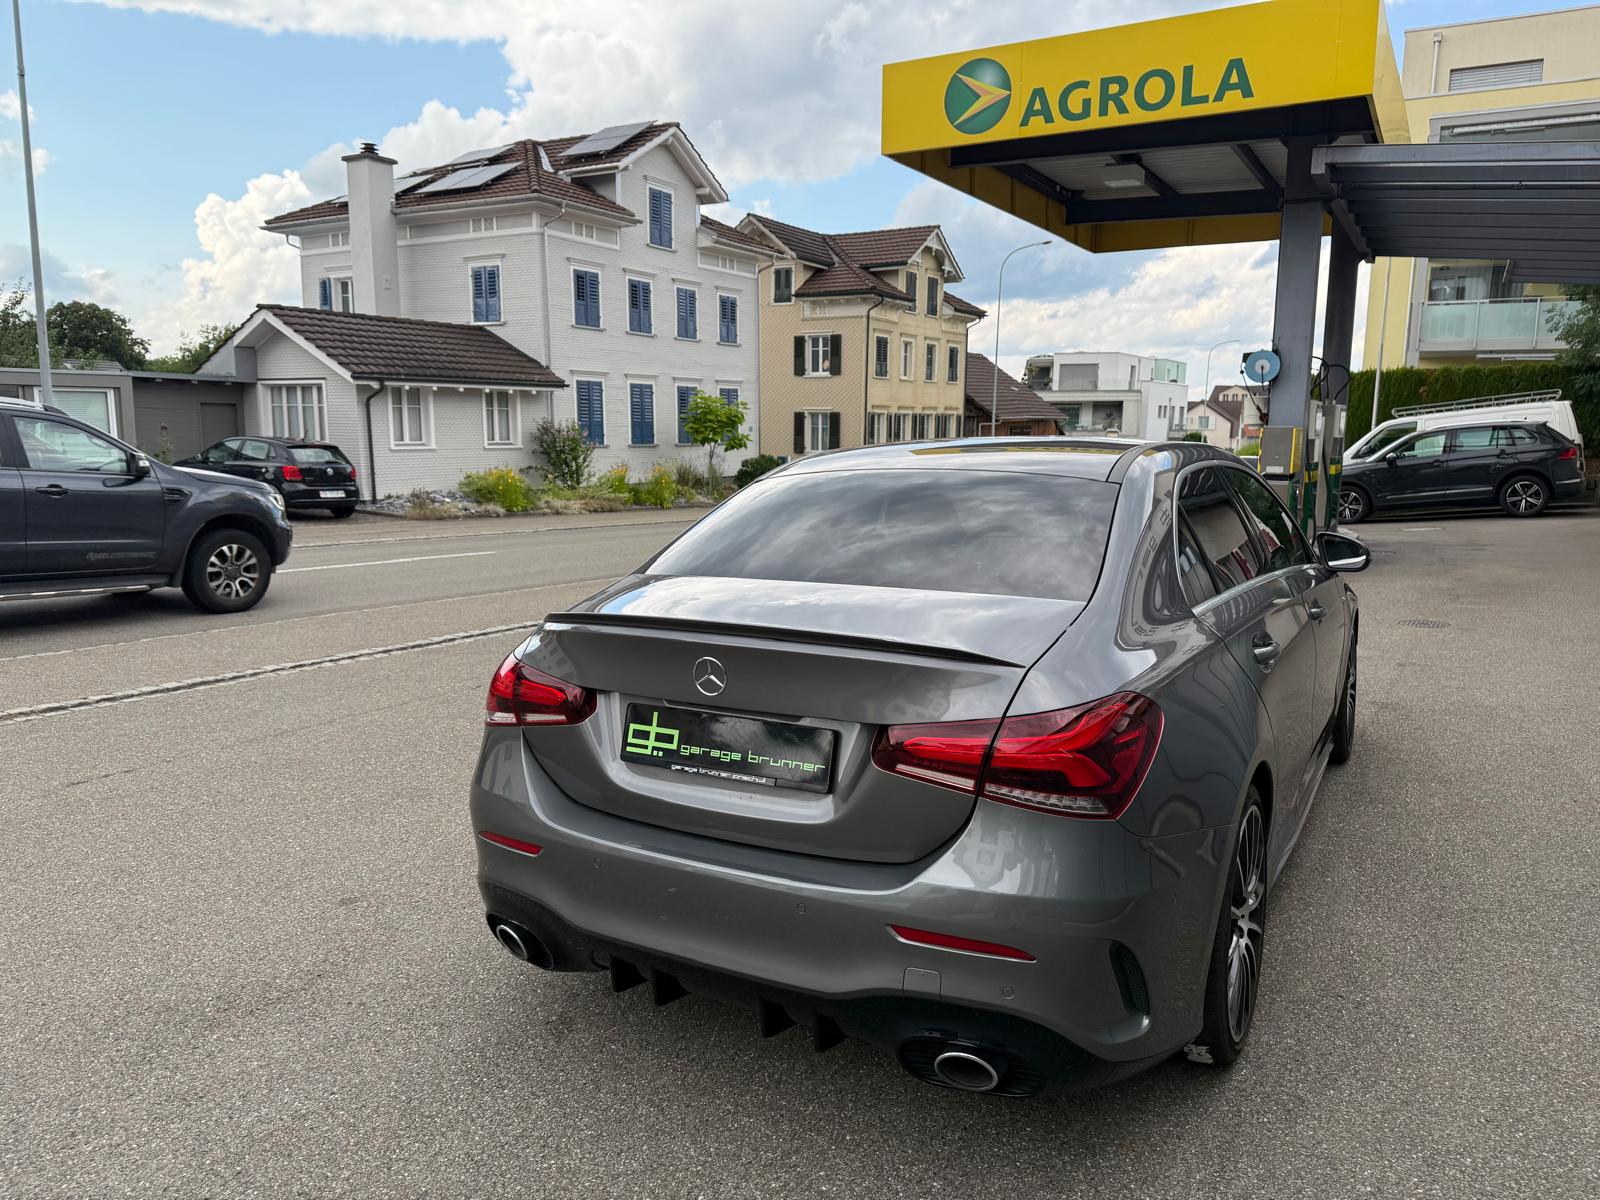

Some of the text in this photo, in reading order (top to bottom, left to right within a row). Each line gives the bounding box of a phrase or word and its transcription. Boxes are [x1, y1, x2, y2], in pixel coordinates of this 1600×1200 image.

[1019, 57, 1254, 127] AGROLA
[671, 764, 698, 774] garage
[680, 744, 825, 773] garage brunner
